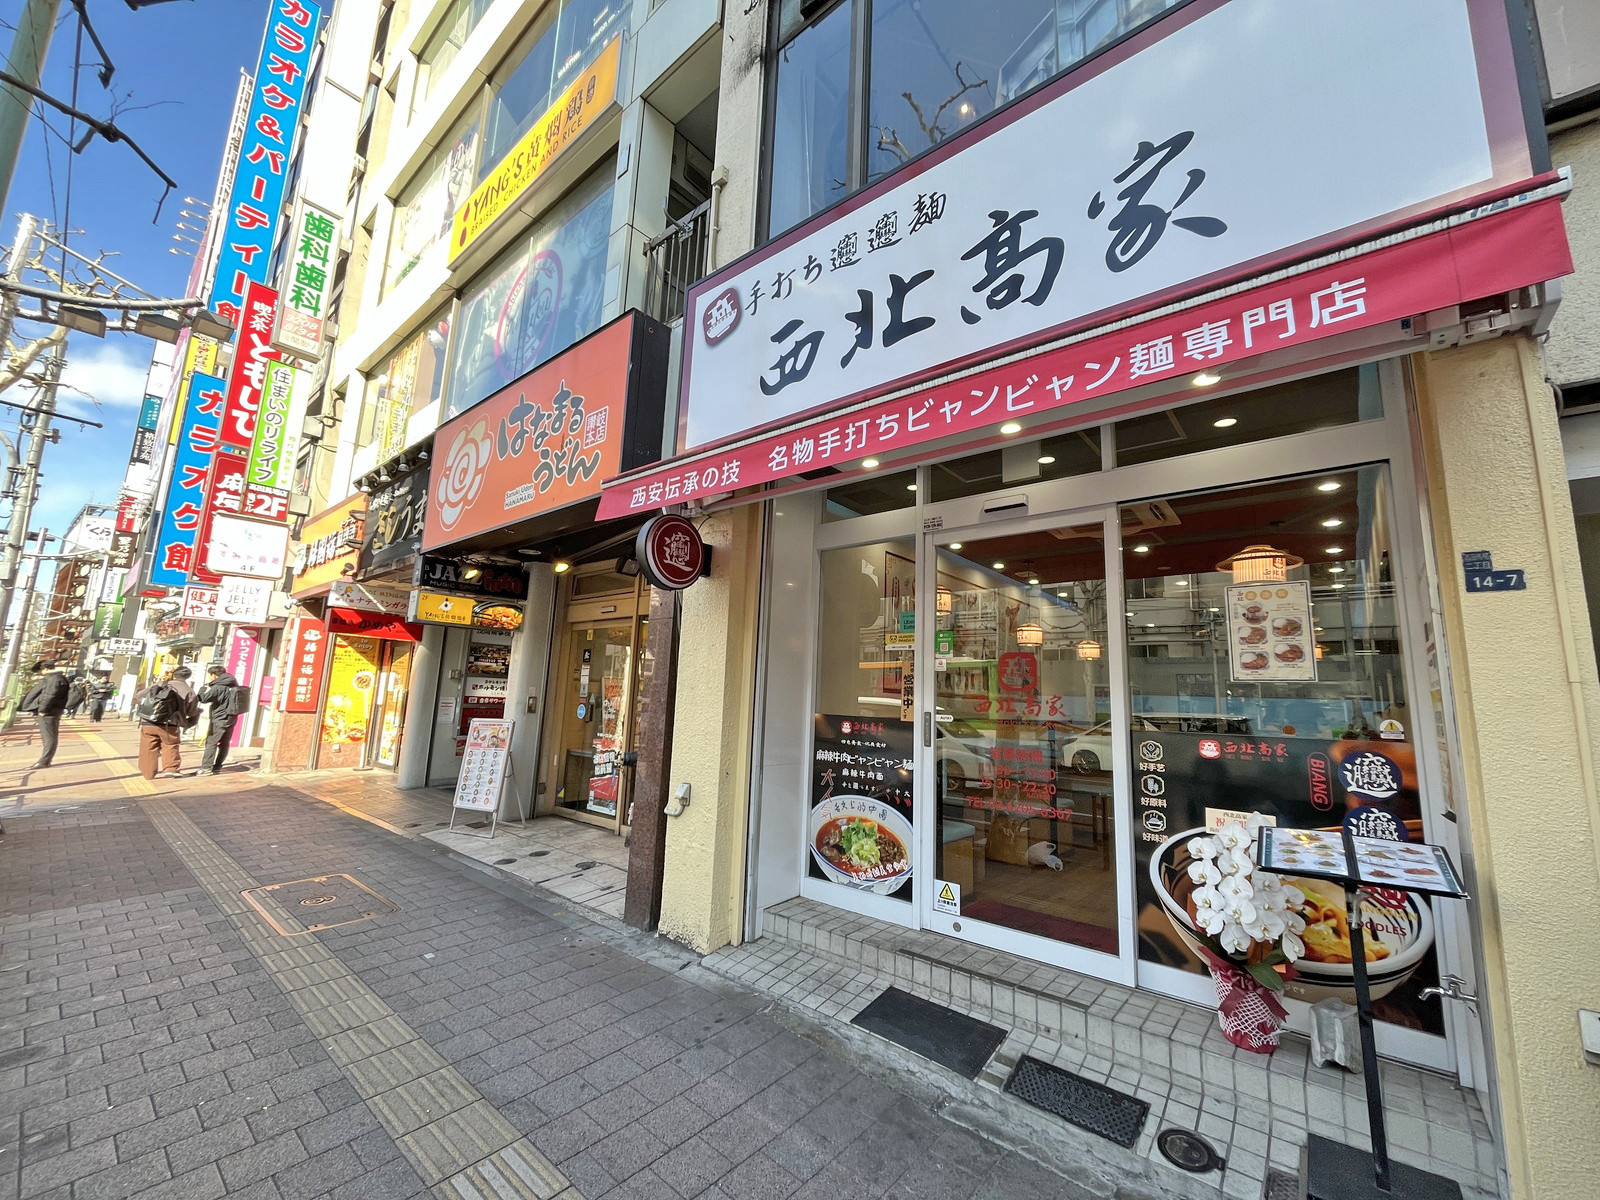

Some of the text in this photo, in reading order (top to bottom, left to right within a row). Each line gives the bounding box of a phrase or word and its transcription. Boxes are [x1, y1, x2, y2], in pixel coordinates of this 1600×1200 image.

[470, 114, 583, 235] BRAISED CHICKEN AND RICE
[473, 152, 524, 222] YANG'S
[254, 366, 292, 482] 住まいのリライフ
[497, 379, 585, 461] はなまる
[532, 436, 602, 493] うどん
[629, 460, 741, 509] 西安伝承の技
[255, 494, 288, 518] 2F
[504, 492, 536, 509] HANAMARU
[228, 583, 262, 595] JELLY
[1472, 573, 1518, 589] 14-7
[421, 594, 430, 602] 2F
[224, 605, 258, 617] CAFE
[1139, 761, 1167, 773] 好手艺
[1308, 757, 1329, 807] BIANG
[1140, 796, 1168, 809] 好原料
[1141, 831, 1169, 844] 好味道
